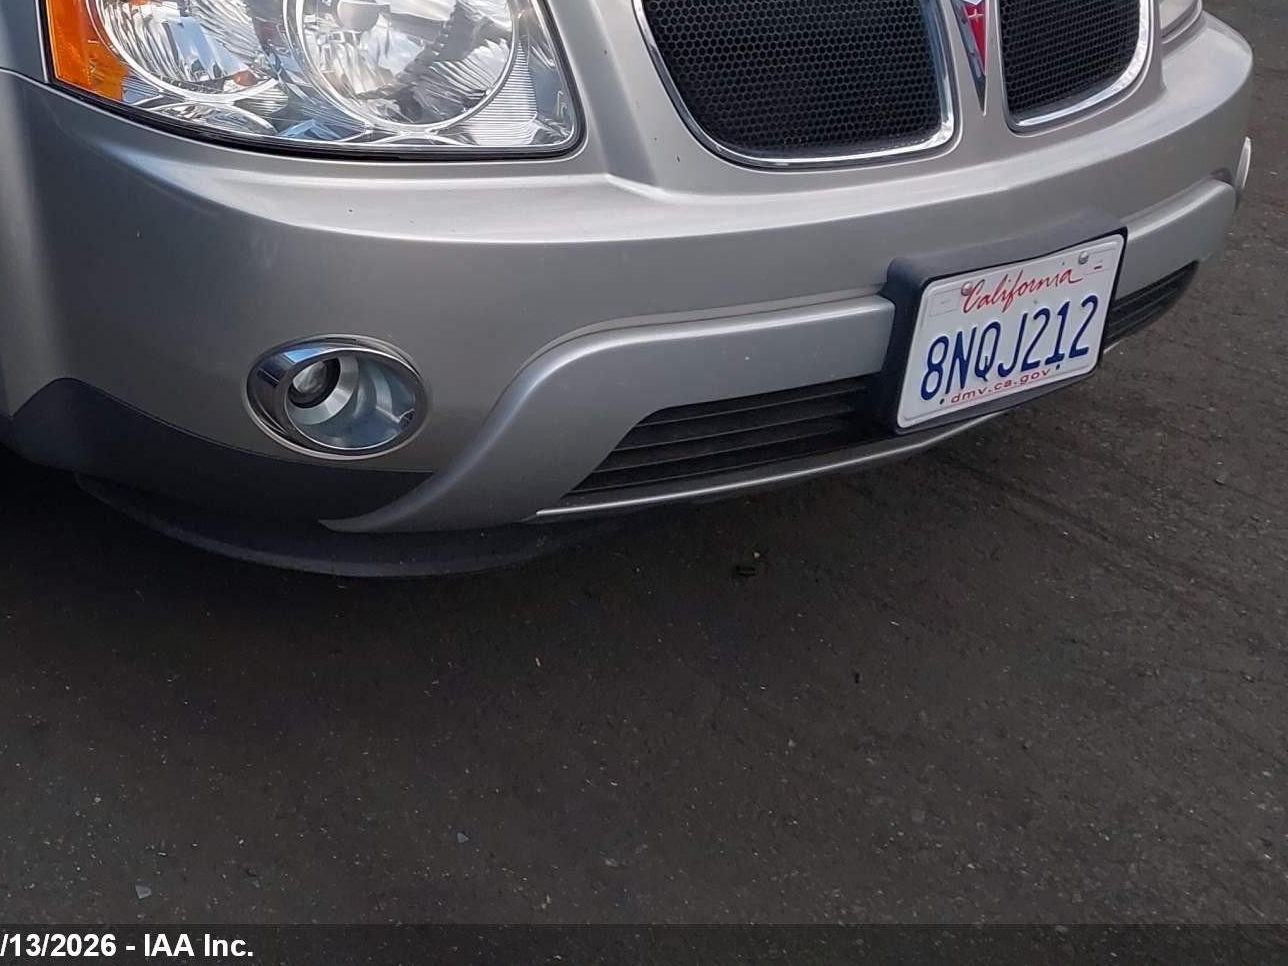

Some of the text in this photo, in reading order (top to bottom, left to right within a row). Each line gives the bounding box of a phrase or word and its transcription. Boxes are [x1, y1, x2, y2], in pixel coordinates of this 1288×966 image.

[961, 268, 1082, 313] California
[920, 294, 1099, 401] 8NQJ212
[950, 367, 1051, 403] dmv.ca.gov
